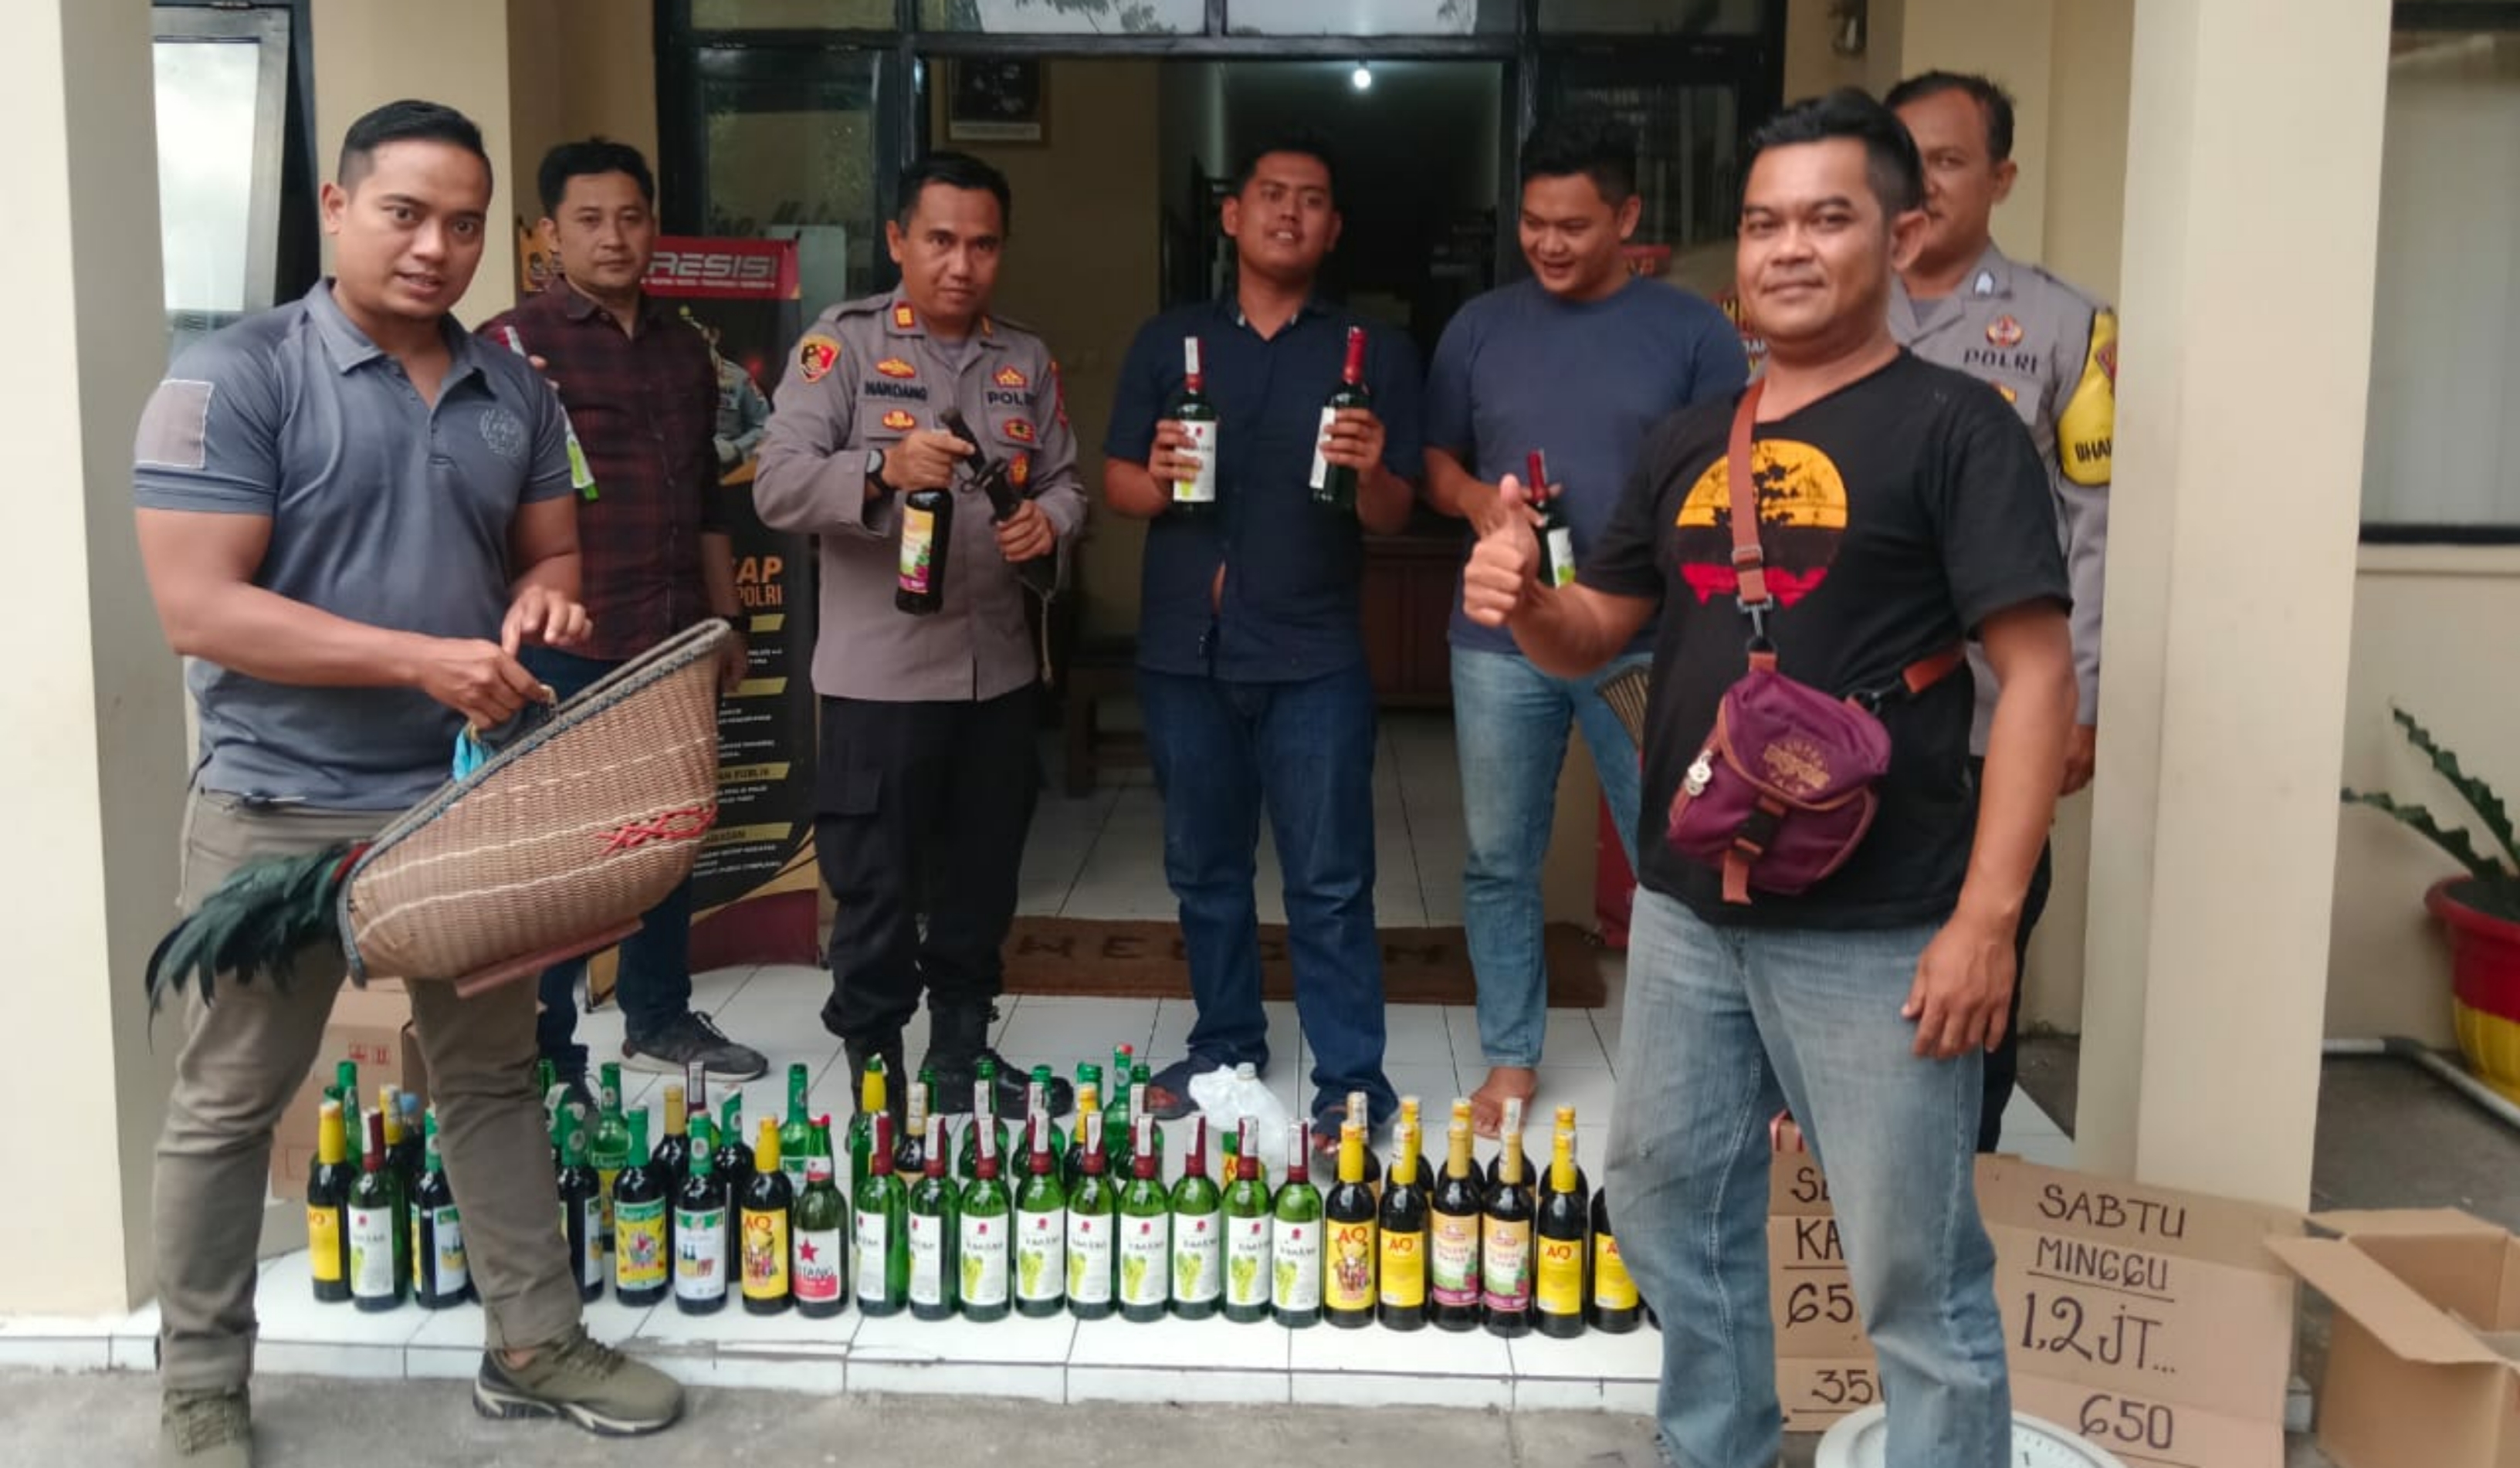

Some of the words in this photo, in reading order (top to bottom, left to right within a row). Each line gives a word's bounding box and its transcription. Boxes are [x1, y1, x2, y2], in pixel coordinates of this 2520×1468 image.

[645, 251, 777, 279] RESISI
[1963, 350, 2038, 375] POLRI
[732, 556, 783, 583] AP
[2037, 1184, 2186, 1240] SABTU
[2036, 1236, 2168, 1291] MINGGU
[2080, 1394, 2173, 1449] 650
